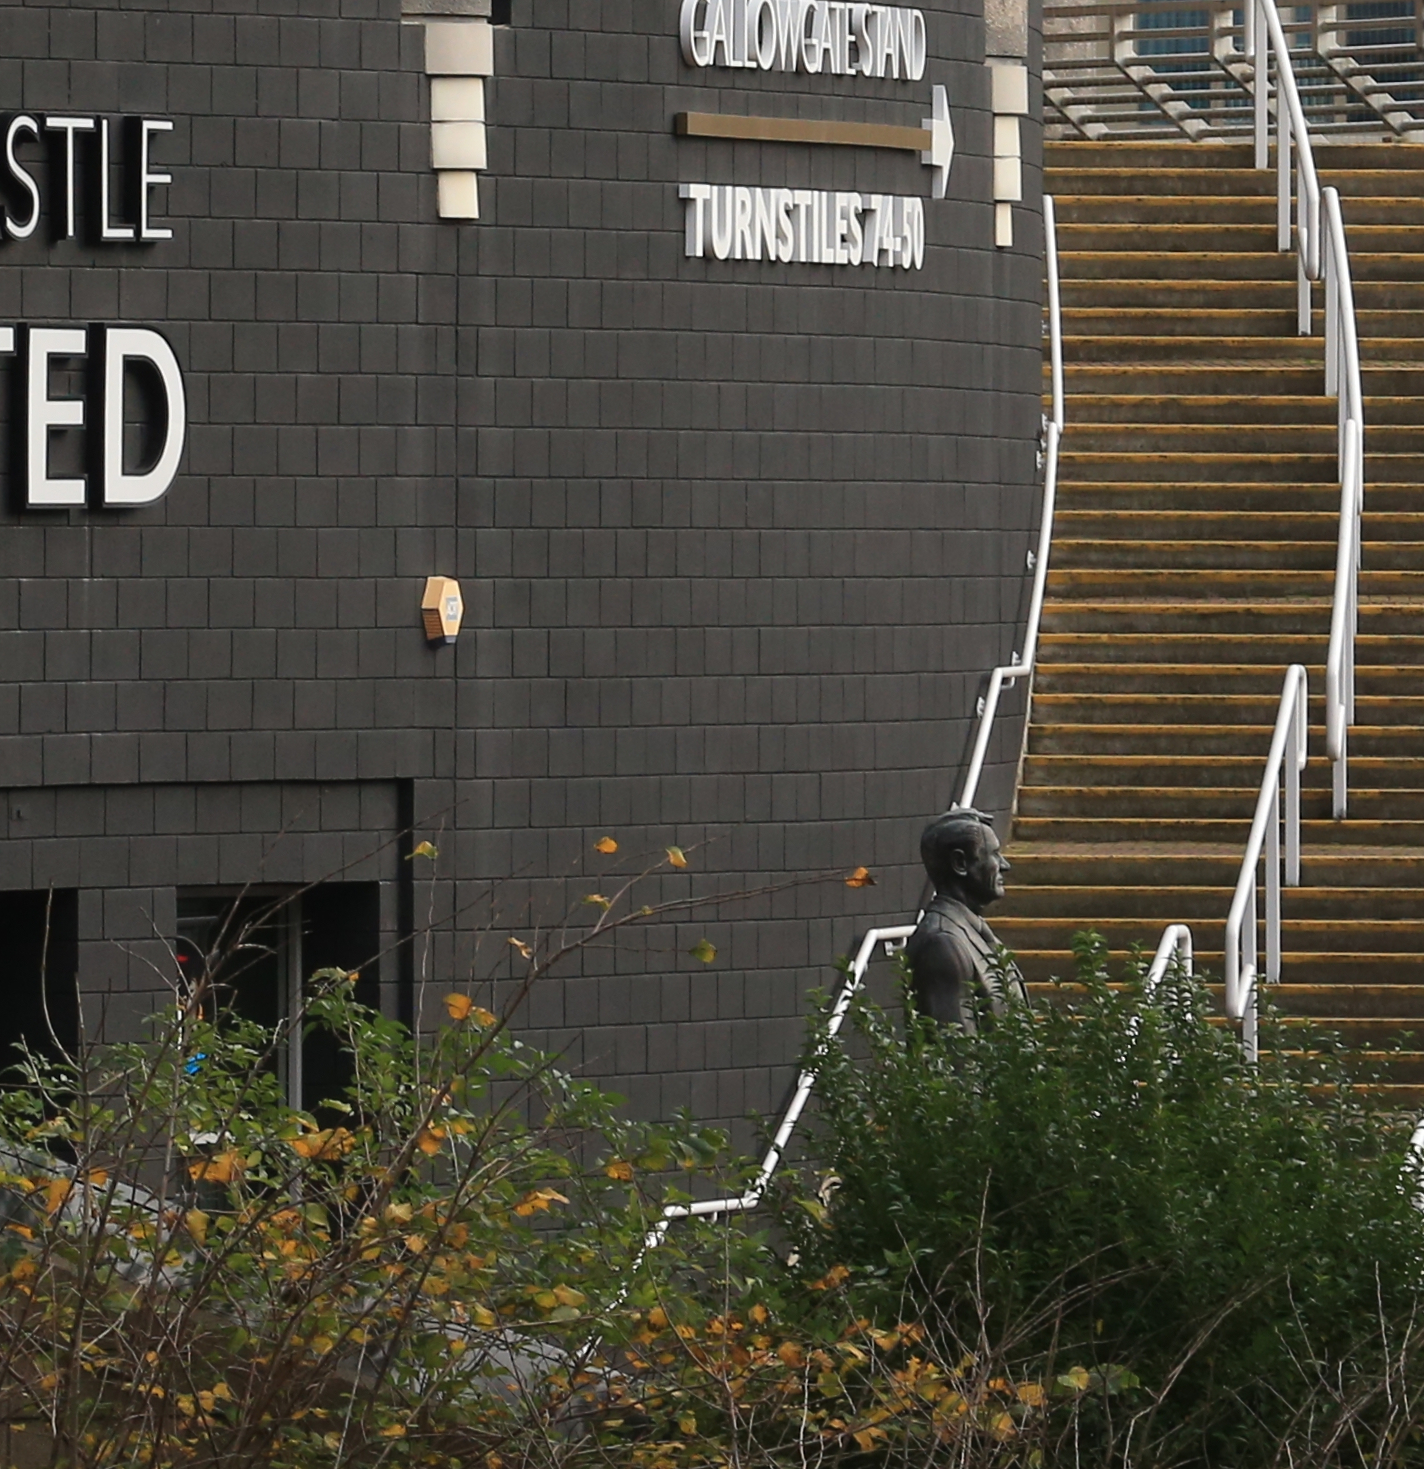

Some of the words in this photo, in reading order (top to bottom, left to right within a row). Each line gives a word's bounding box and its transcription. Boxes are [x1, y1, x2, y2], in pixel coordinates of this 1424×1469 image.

[854, 2, 926, 81] STAND
[679, 183, 863, 267] TURNSTILES
[863, 193, 925, 270] 74-50
